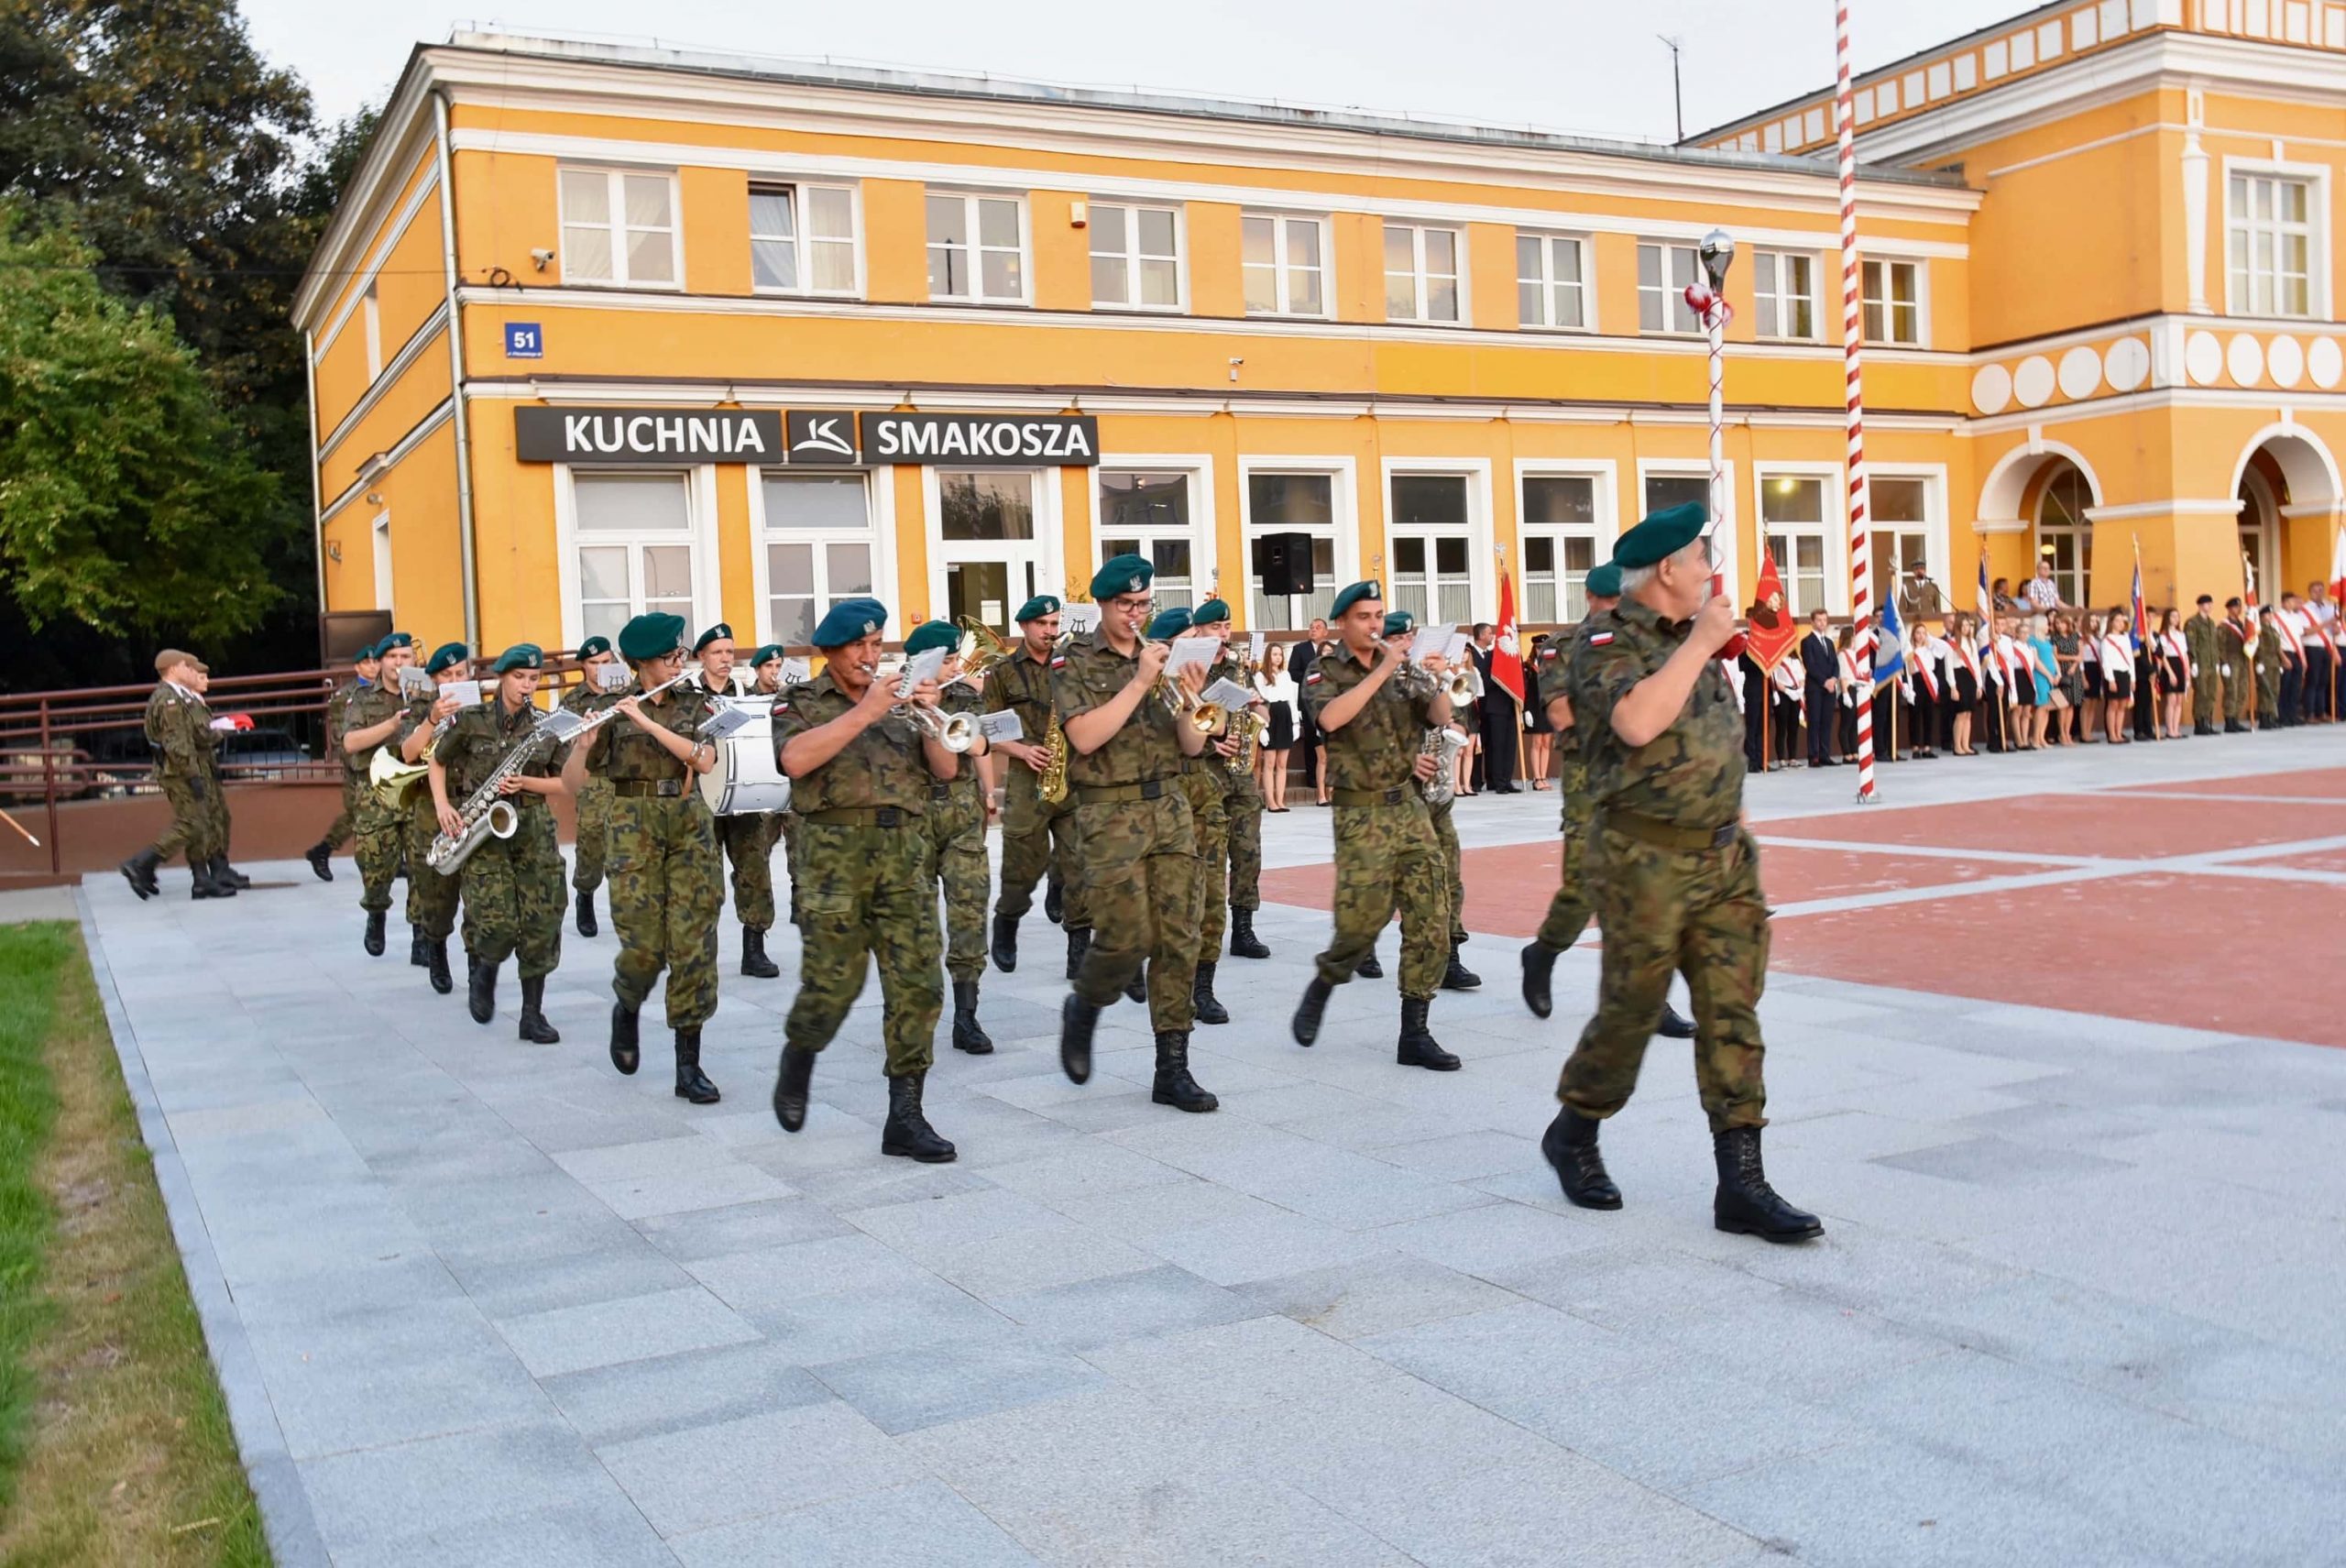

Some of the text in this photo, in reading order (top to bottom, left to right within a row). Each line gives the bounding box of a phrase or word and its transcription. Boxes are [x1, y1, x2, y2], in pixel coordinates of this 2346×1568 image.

[513, 331, 534, 349] 51
[565, 415, 765, 454] KUCHNIA
[877, 420, 1091, 456] SMAKOSZA
